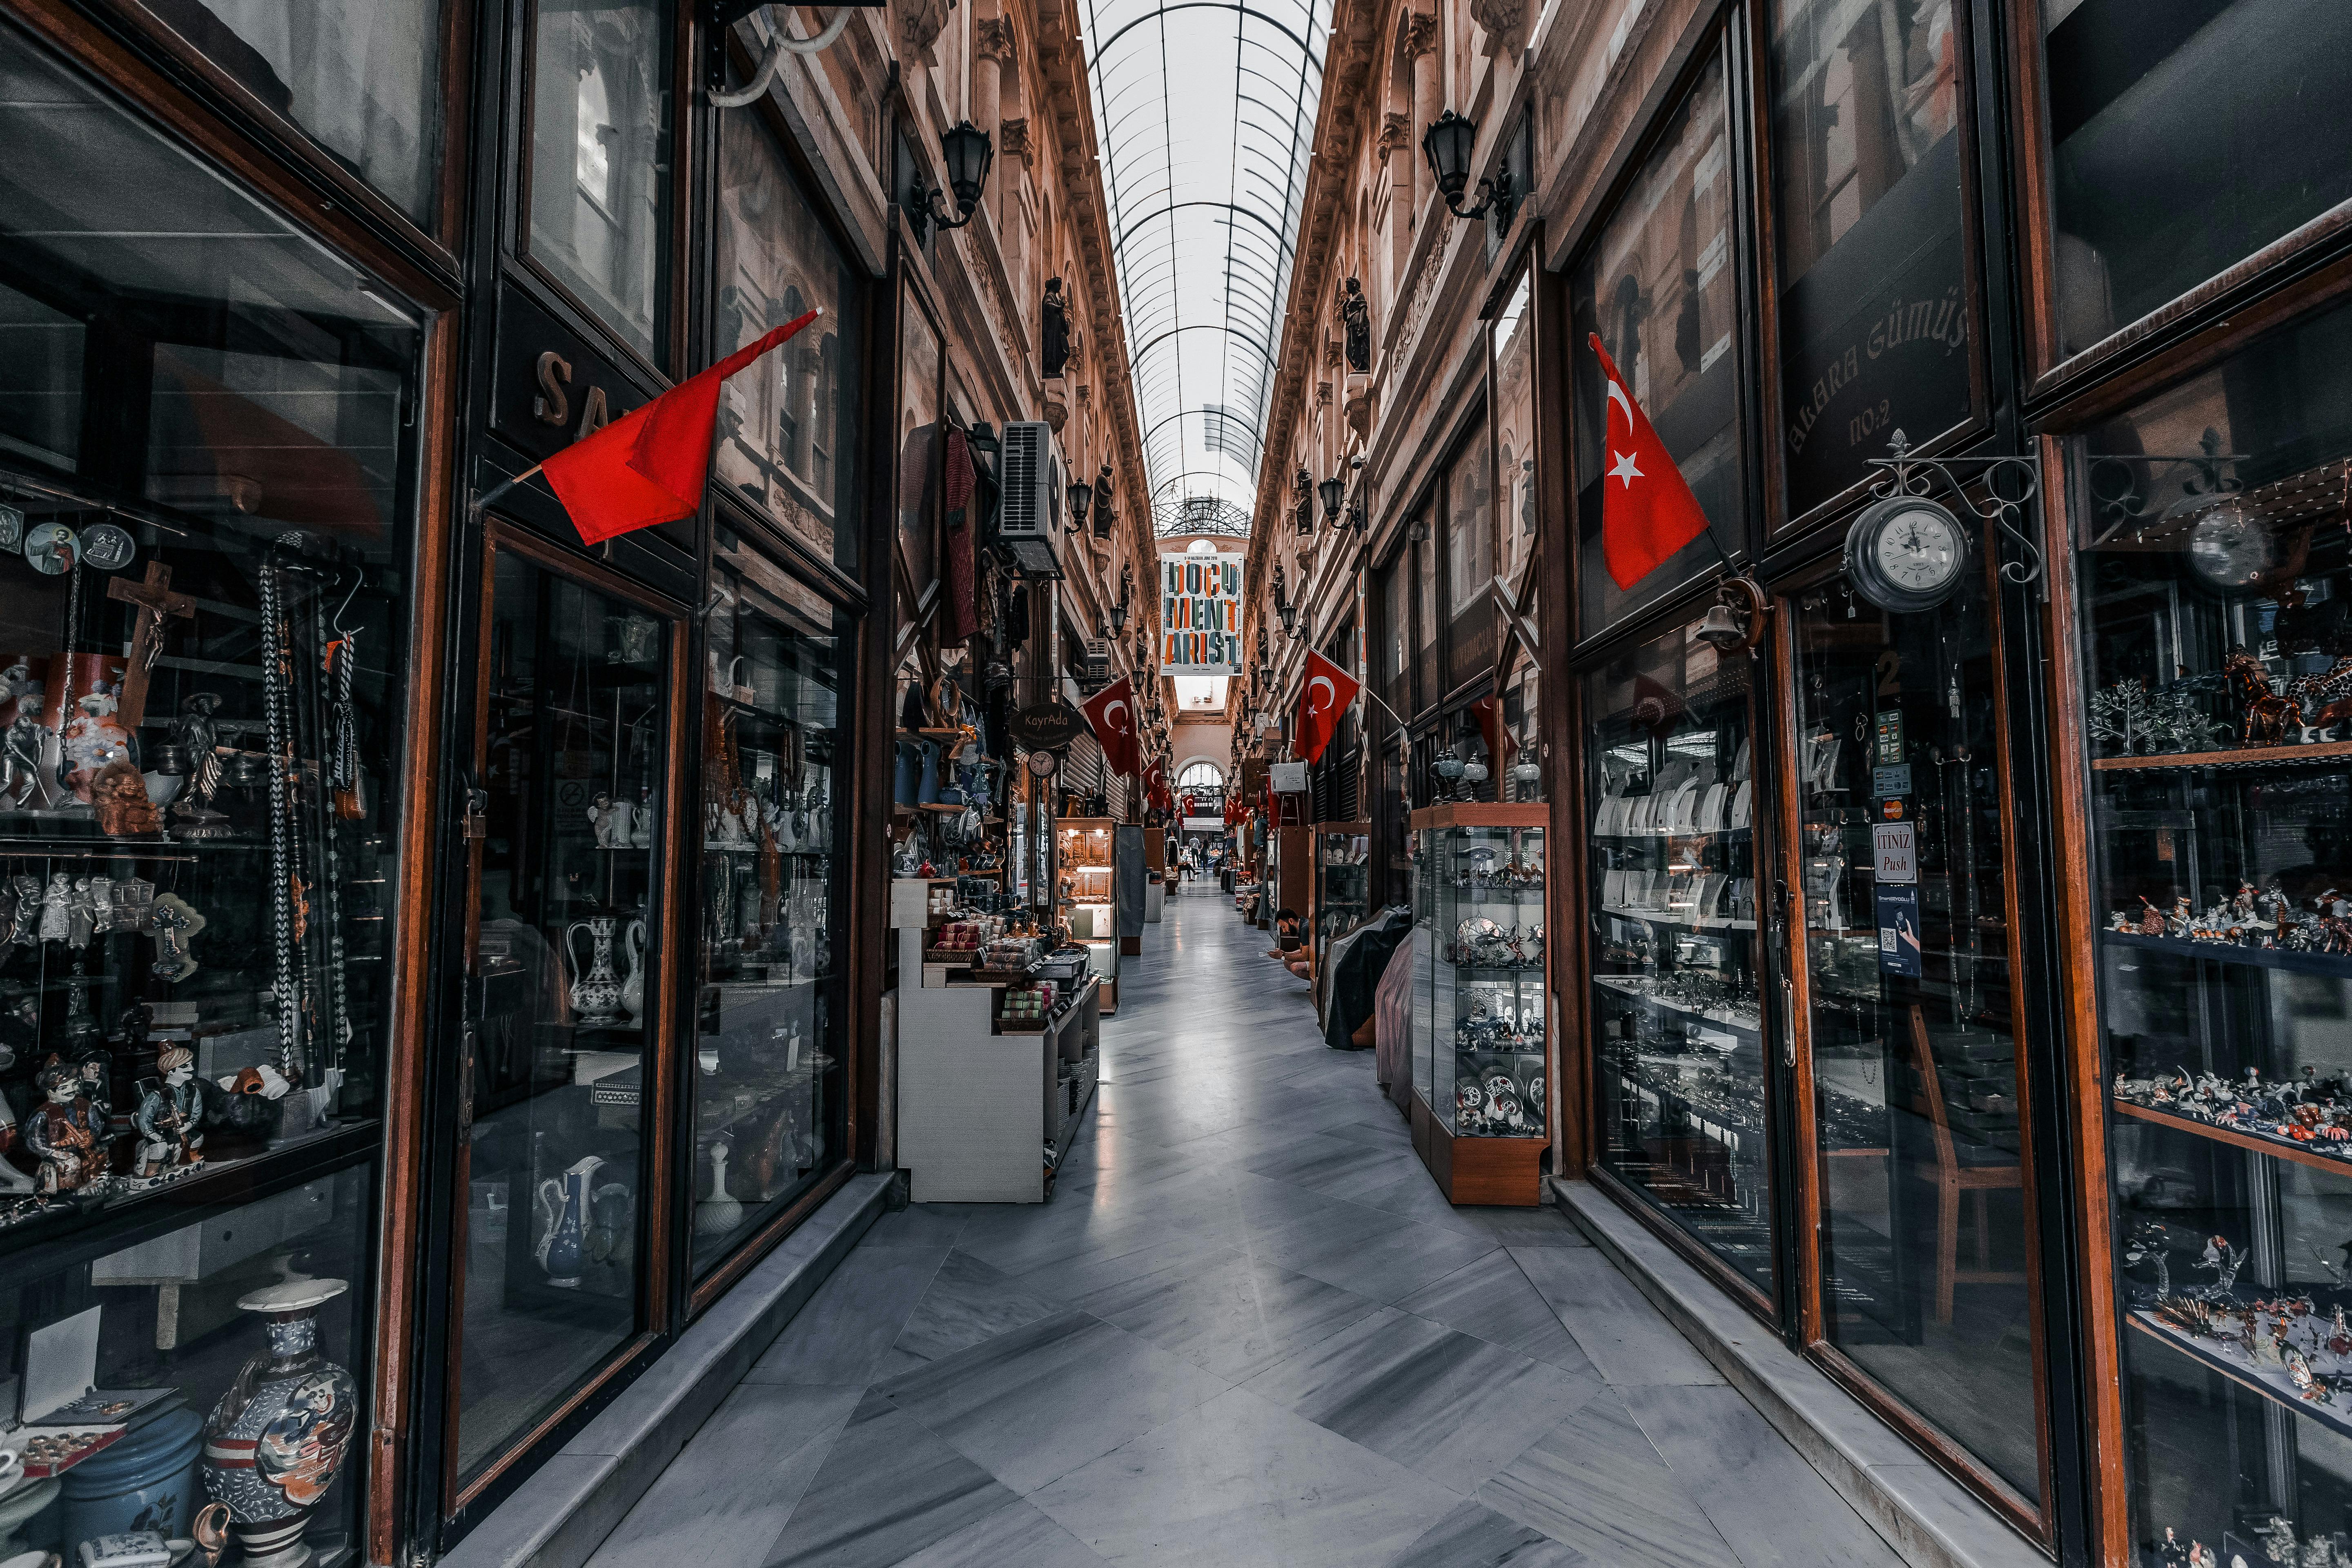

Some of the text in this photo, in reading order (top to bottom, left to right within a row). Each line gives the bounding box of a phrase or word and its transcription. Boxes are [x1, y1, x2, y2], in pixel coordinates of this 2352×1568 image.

[1894, 526, 1903, 535] 11
[1923, 523, 1929, 532] 1
[1885, 537, 1895, 546] 10
[1169, 561, 1237, 598] DOCU
[1901, 571, 1909, 580] 7
[1915, 572, 1921, 582] 6
[1166, 597, 1236, 633] MENT
[1165, 631, 1236, 666] ARIST
[1025, 710, 1068, 731] KayrAda
[1877, 830, 1911, 849] İTİNİZ
[1882, 856, 1907, 871] Push
